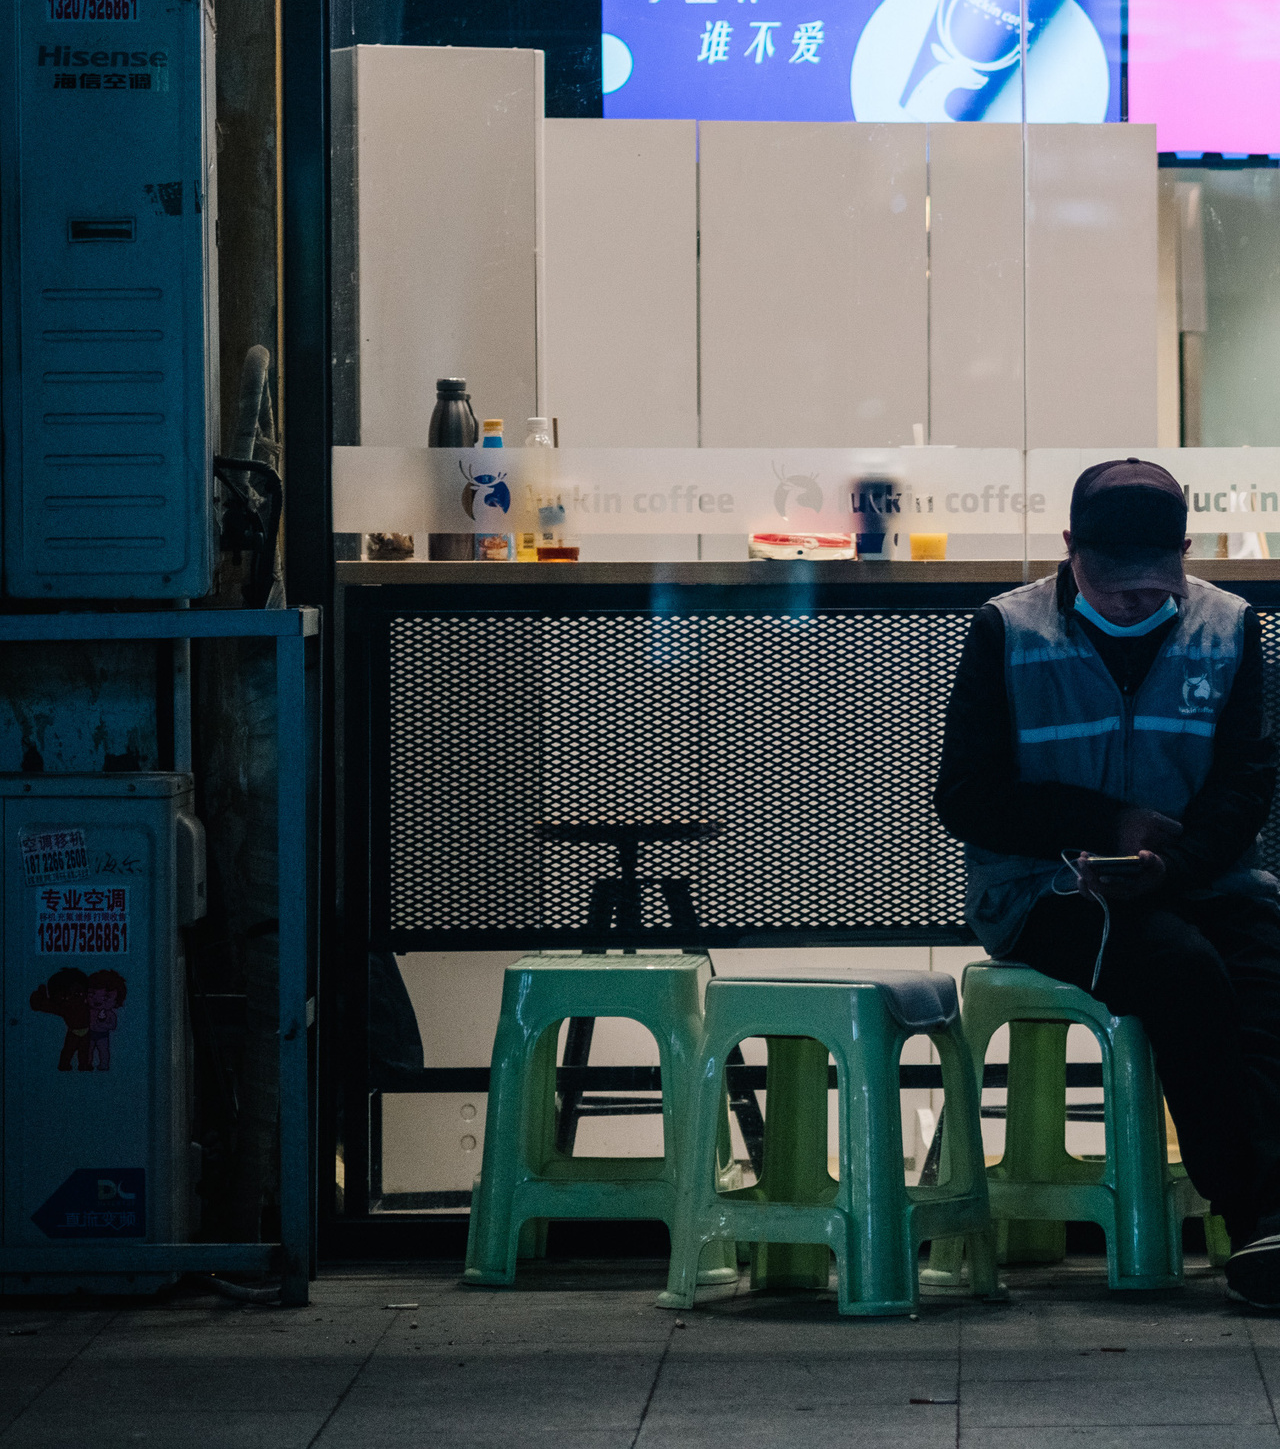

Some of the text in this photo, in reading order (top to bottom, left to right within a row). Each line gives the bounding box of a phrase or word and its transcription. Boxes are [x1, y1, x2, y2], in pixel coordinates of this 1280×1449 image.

[38, 45, 168, 67] Hisense
[697, 20, 824, 64] 谁不爱
[53, 73, 151, 89] 海信空调
[632, 484, 734, 514] coffee
[945, 484, 1047, 514] coffee
[1183, 484, 1279, 513] luckin
[41, 889, 126, 912] 专业空调
[38, 923, 128, 952] 13207526861
